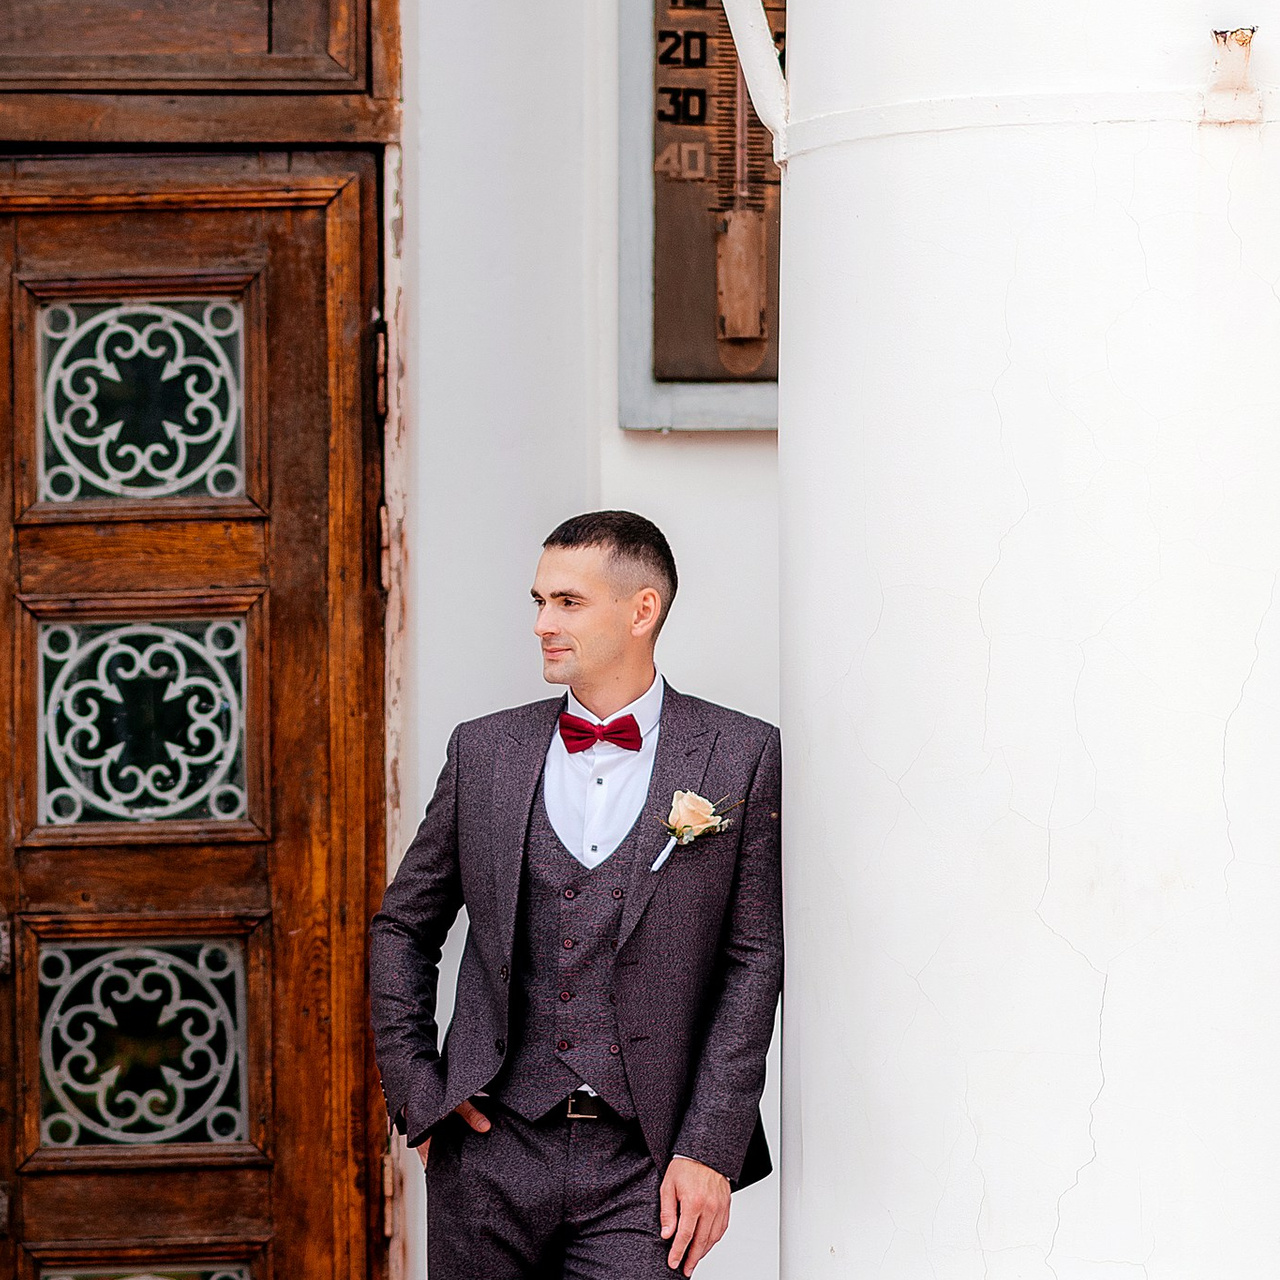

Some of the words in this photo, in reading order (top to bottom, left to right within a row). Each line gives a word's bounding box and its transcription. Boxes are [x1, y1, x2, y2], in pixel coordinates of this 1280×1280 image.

[658, 30, 707, 67] 20
[657, 87, 707, 125] 30
[655, 141, 707, 178] 40
